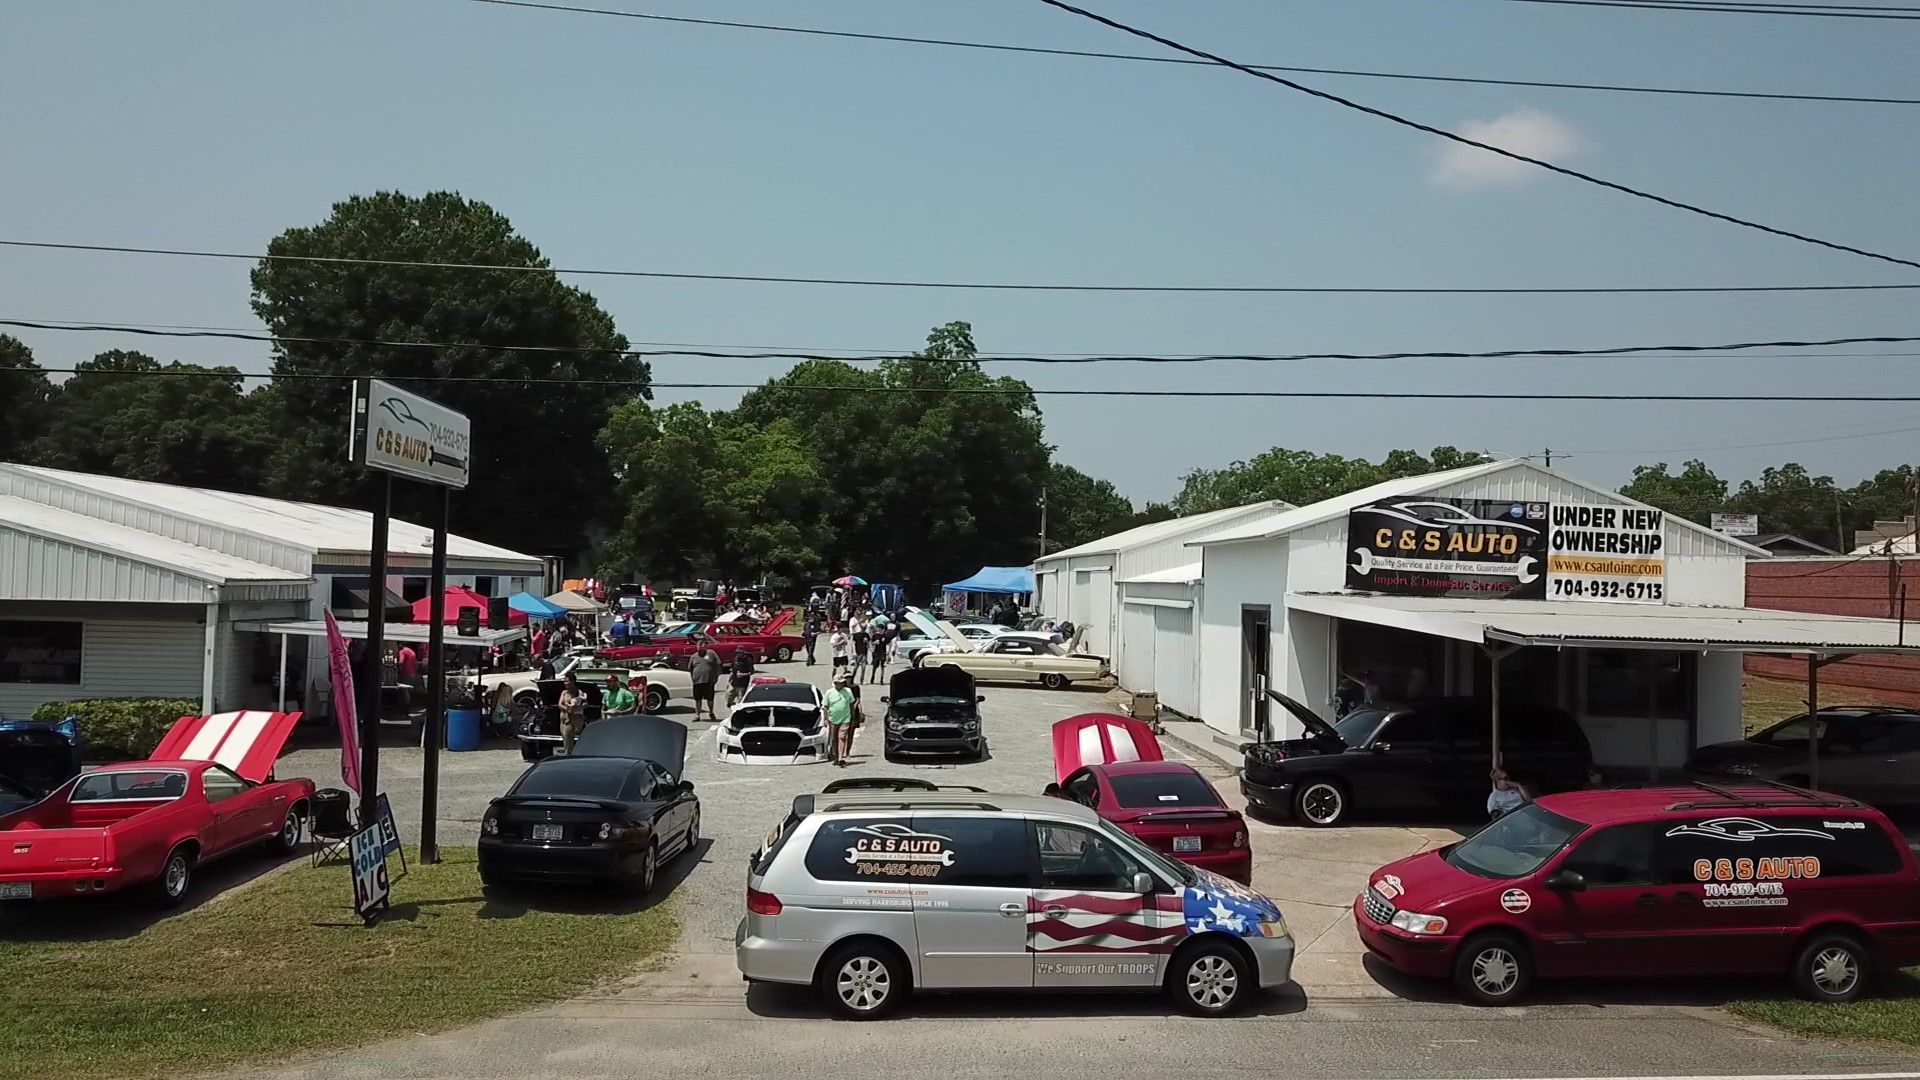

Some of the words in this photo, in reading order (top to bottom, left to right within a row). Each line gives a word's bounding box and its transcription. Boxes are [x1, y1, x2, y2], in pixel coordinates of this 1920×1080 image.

[376, 427, 384, 451] C
[385, 430, 393, 454] &
[394, 433, 402, 456] S
[402, 436, 427, 462] AUTO
[1553, 505, 1616, 529] UNDER
[1622, 508, 1663, 531] NEW
[1375, 528, 1393, 548] C
[1399, 529, 1417, 550] &
[1424, 530, 1441, 551] S
[1447, 532, 1518, 555] AUTO
[1552, 529, 1662, 554] OWNERSHIP
[1371, 557, 1395, 569] Quality
[1396, 559, 1423, 569] Service
[1425, 561, 1432, 570] at
[1440, 562, 1453, 571] Fair
[1455, 562, 1475, 572] Price,
[1476, 562, 1519, 573] Guaranteed!
[1554, 560, 1662, 575] www.csautoinc.com
[1373, 574, 1408, 587] Import
[1422, 577, 1469, 591] Domestic
[1472, 580, 1516, 592] Services
[1554, 578, 1662, 600] 704-932-6713
[857, 838, 868, 851] C
[870, 839, 882, 851] &
[885, 839, 896, 852] S
[899, 840, 941, 853] AUTO
[355, 845, 381, 877] COLD
[1694, 859, 1712, 880] C
[1715, 858, 1734, 880] &
[1736, 857, 1755, 880] S
[1756, 856, 1820, 879] AUTO
[359, 863, 387, 907] A/C
[1704, 882, 1784, 896] 704-932-6713
[1703, 897, 1788, 908] www.csautoinc.com
[1037, 963, 1053, 974] We
[1056, 963, 1095, 975] Support
[1098, 963, 1115, 974] Our
[1117, 963, 1155, 974] TROOPS
